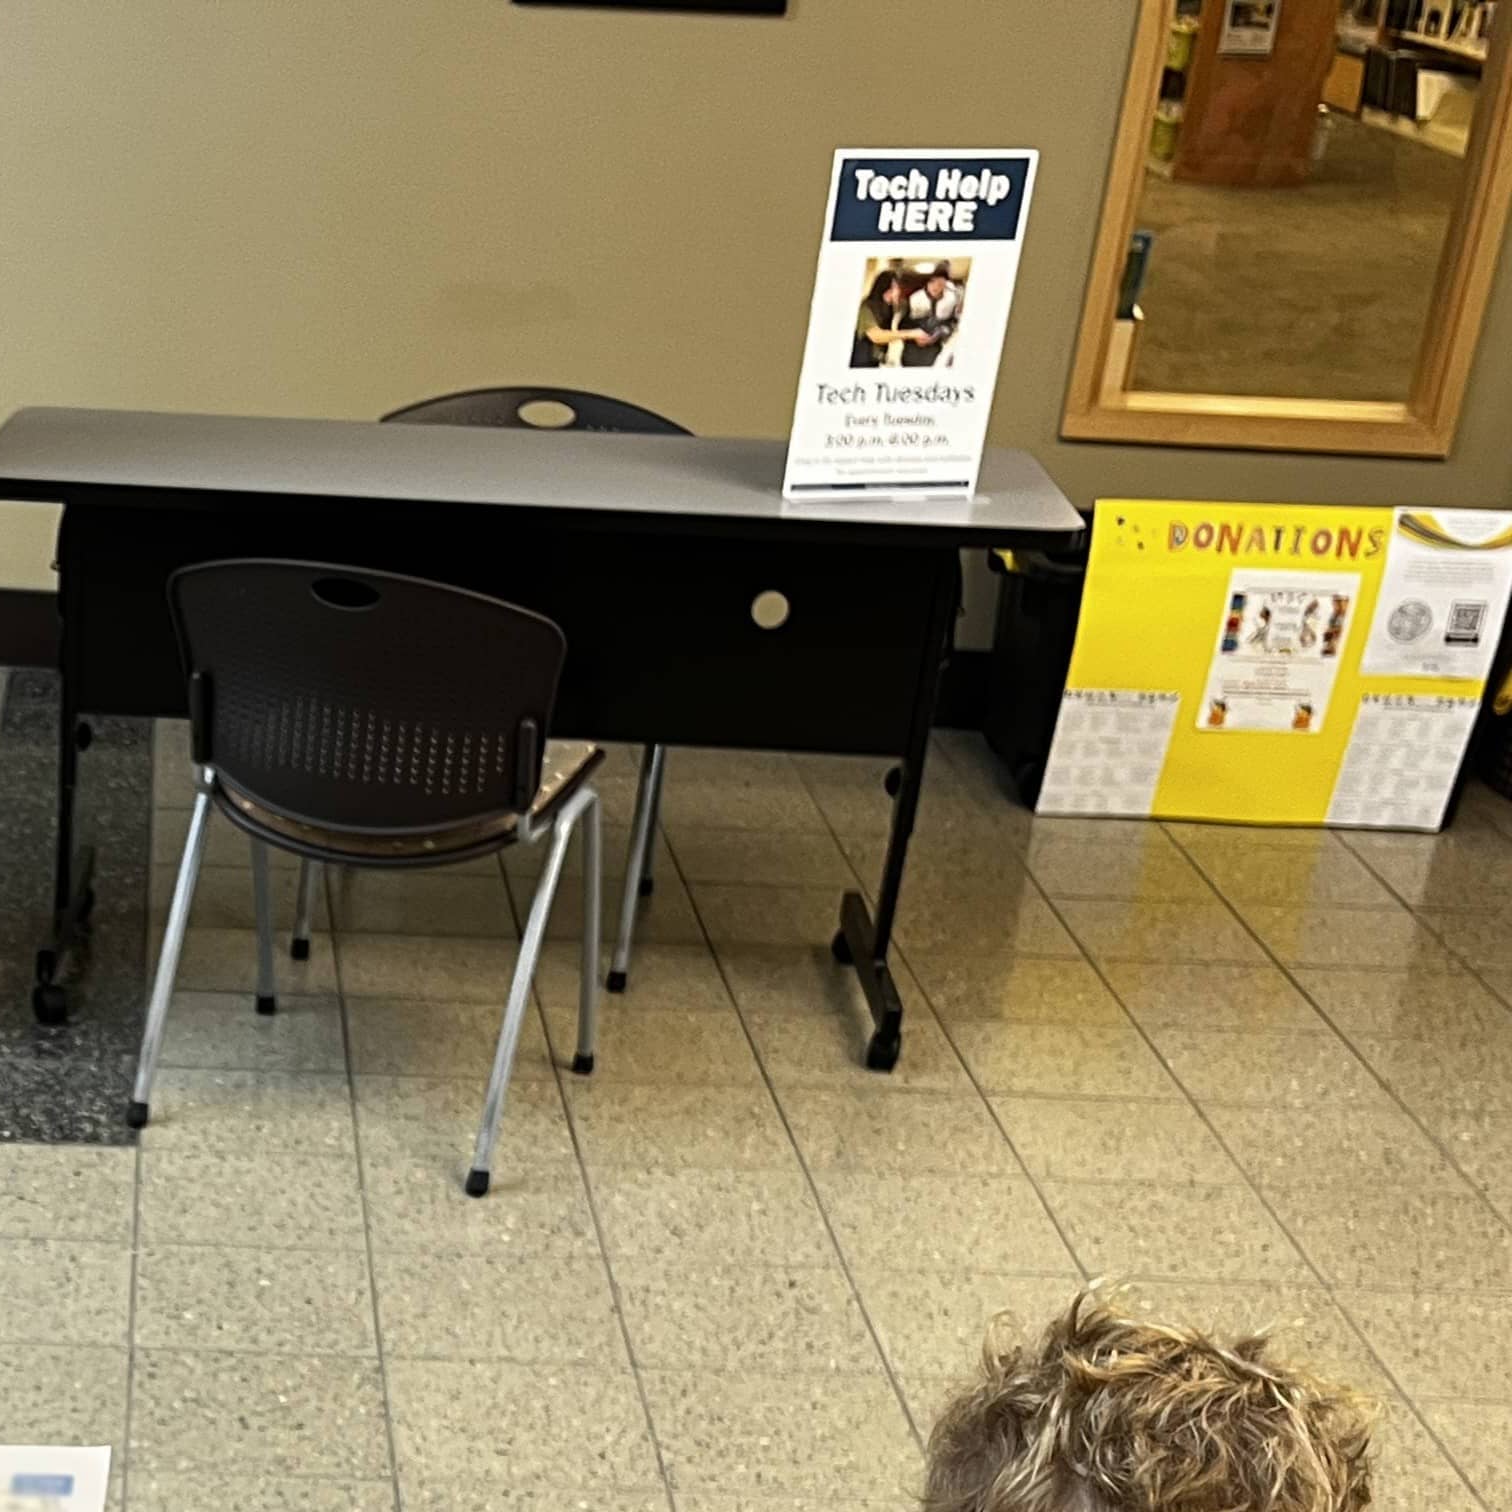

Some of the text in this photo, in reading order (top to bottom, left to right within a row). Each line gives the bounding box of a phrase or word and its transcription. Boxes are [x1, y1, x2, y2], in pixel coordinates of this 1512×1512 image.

[854, 168, 1011, 206] Tech Help
[877, 201, 978, 232] HERE
[816, 381, 975, 407] Tech Tuesdays
[1168, 520, 1385, 560] DONATIONS
